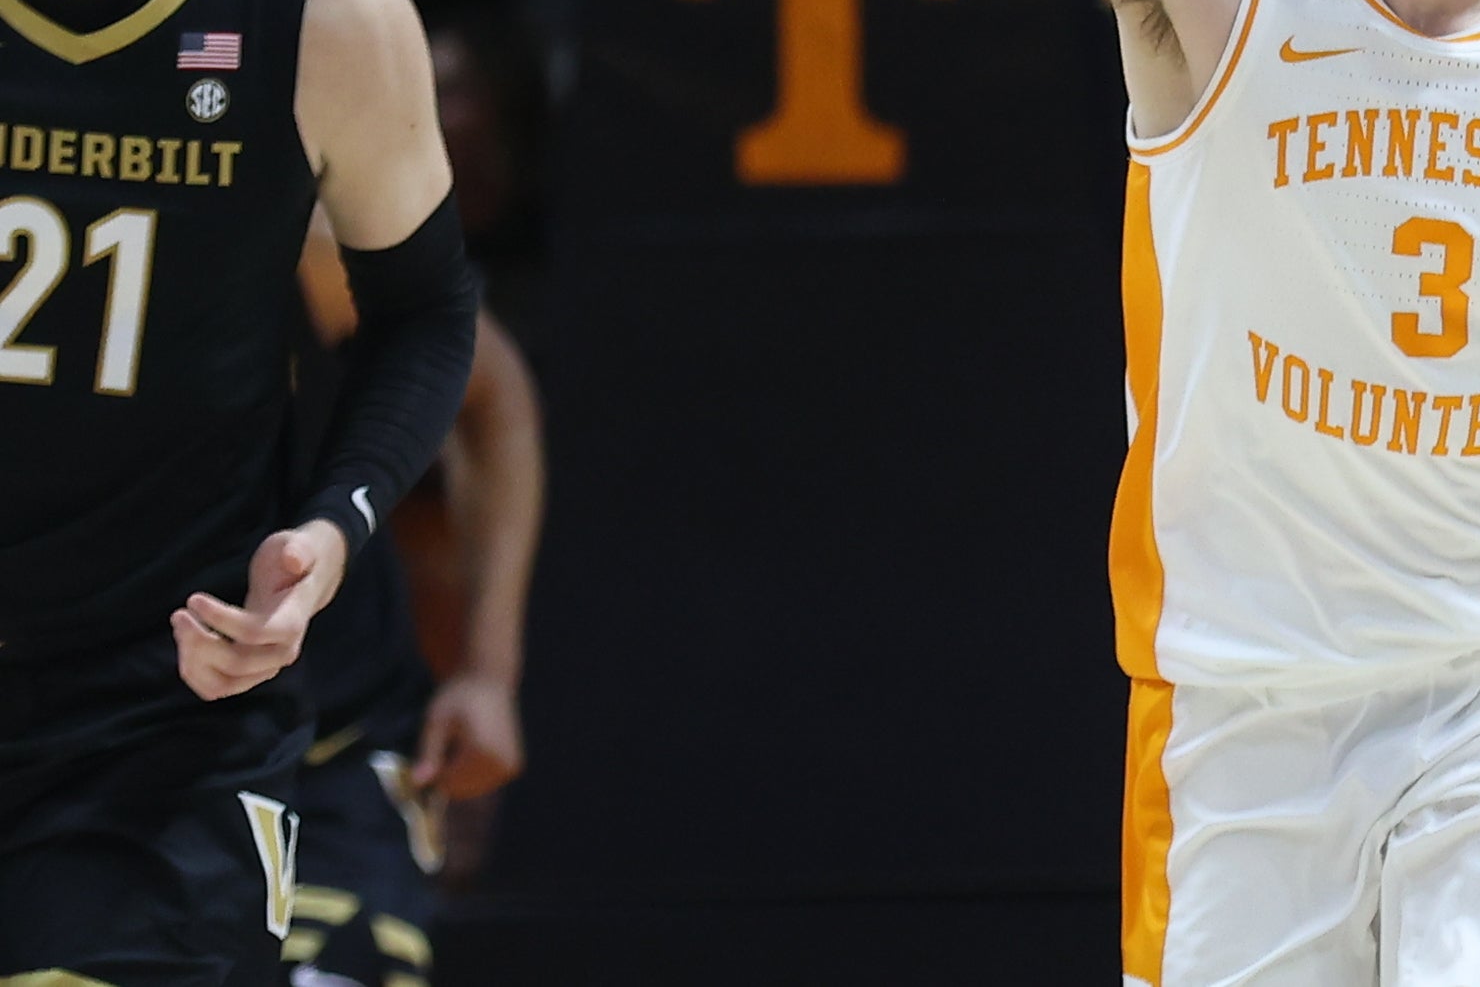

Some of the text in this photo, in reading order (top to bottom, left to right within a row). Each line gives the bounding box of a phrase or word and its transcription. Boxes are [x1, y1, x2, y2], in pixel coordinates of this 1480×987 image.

[0, 122, 243, 187] DERBILT
[0, 195, 158, 397] 21
[1391, 216, 1475, 358] 3
